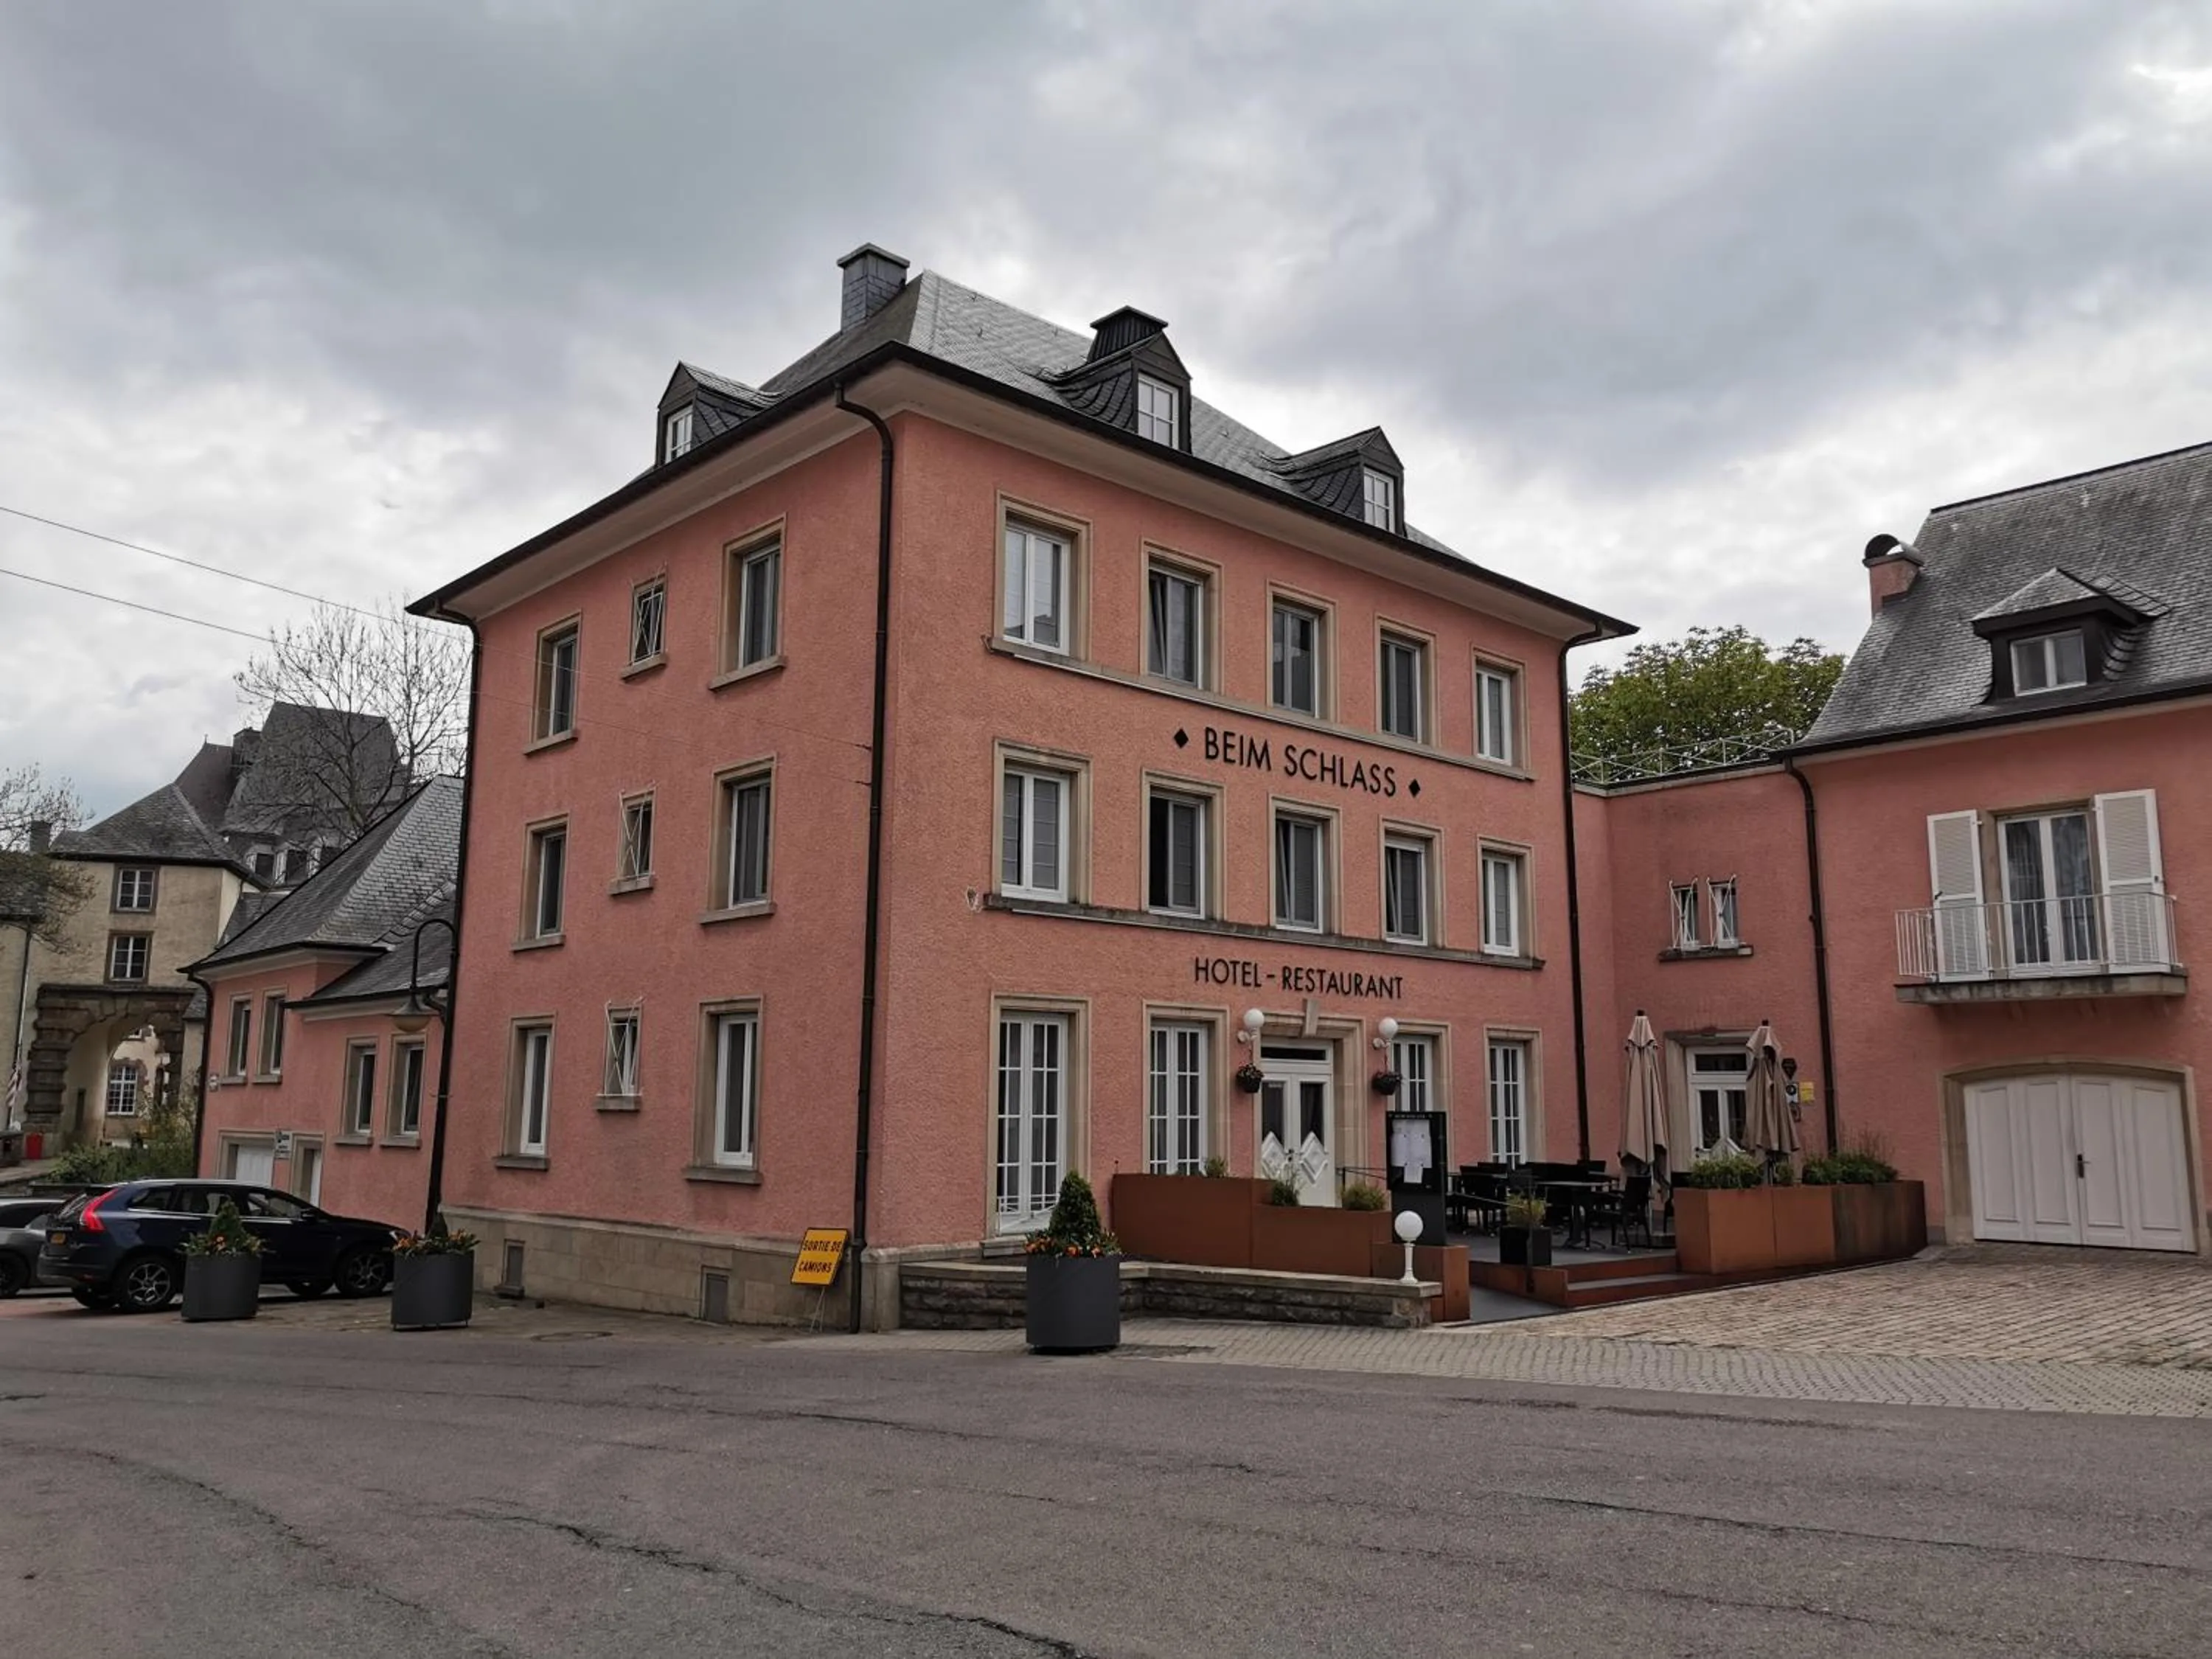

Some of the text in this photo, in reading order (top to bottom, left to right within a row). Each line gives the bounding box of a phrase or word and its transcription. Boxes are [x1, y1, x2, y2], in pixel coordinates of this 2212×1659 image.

[1205, 726, 1396, 797] BEIM SCHLASS
[1194, 956, 1262, 988] HOTEL
[1281, 965, 1403, 999] RESTAURANT
[831, 1240, 842, 1252] DE
